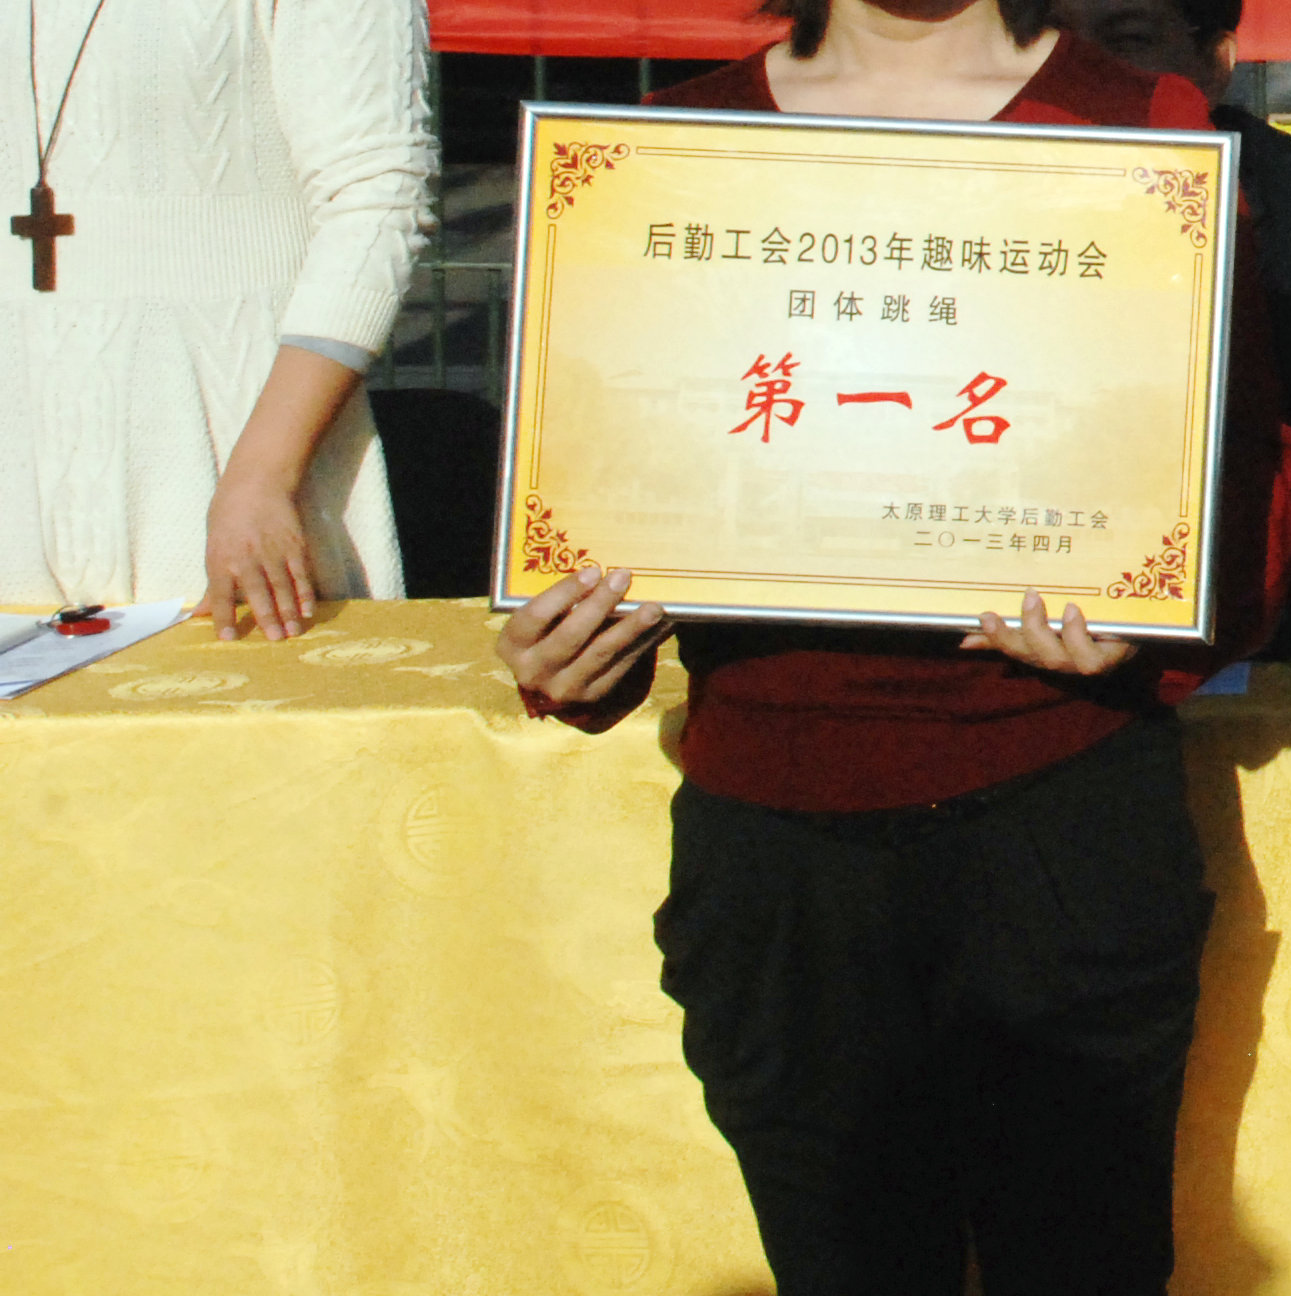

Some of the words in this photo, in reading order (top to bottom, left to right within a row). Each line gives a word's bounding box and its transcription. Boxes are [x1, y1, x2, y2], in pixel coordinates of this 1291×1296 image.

[643, 222, 1109, 280] 后勤工会2013年趣味运动会
[788, 289, 959, 326] 团体跳绳
[728, 351, 1011, 445] 第一名
[882, 502, 1109, 529] 太原理工大学后勤工会
